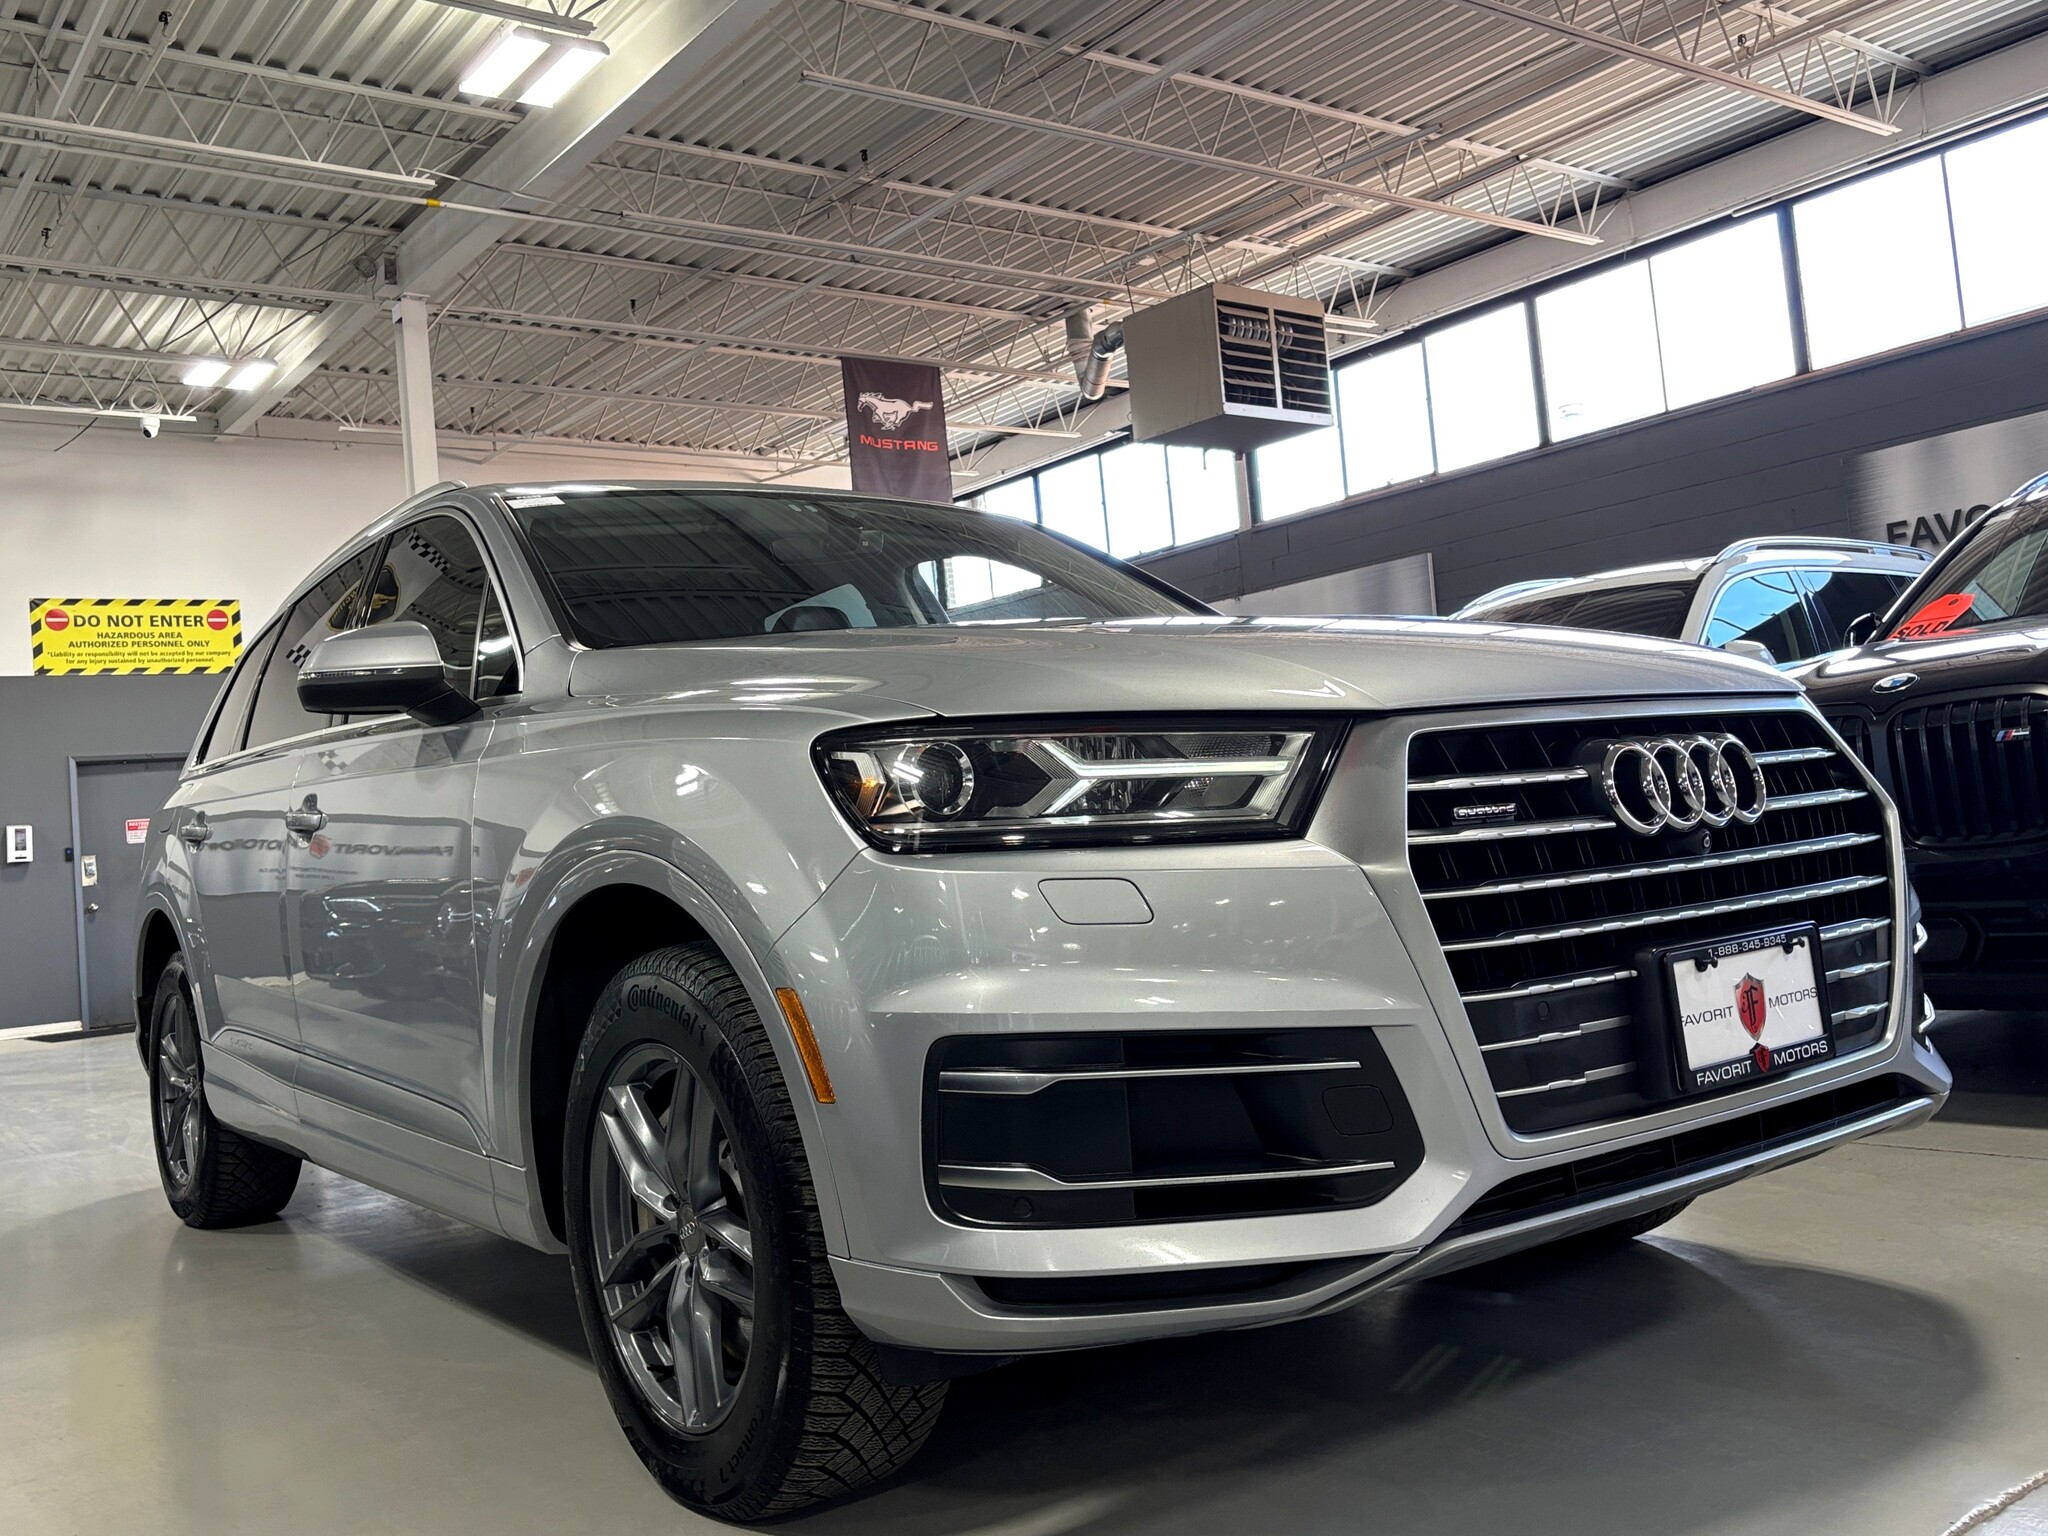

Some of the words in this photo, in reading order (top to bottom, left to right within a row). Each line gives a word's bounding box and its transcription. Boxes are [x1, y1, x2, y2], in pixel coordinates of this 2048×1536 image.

[860, 434, 938, 451] MUSTANG
[73, 615, 101, 628] DO
[107, 615, 144, 628] NOT
[149, 615, 204, 627] ENTER
[1893, 621, 1949, 640] SOLD
[131, 640, 185, 648] PERSONNEL
[187, 640, 210, 648] ONLY
[158, 631, 183, 639] AREA
[1707, 934, 1787, 958] 1-888-345-9345
[1768, 987, 1818, 1008] MOTORS
[627, 984, 698, 1036] Continental
[1696, 1061, 1752, 1086] FAVORIT
[1773, 1040, 1828, 1065] MOTORS
